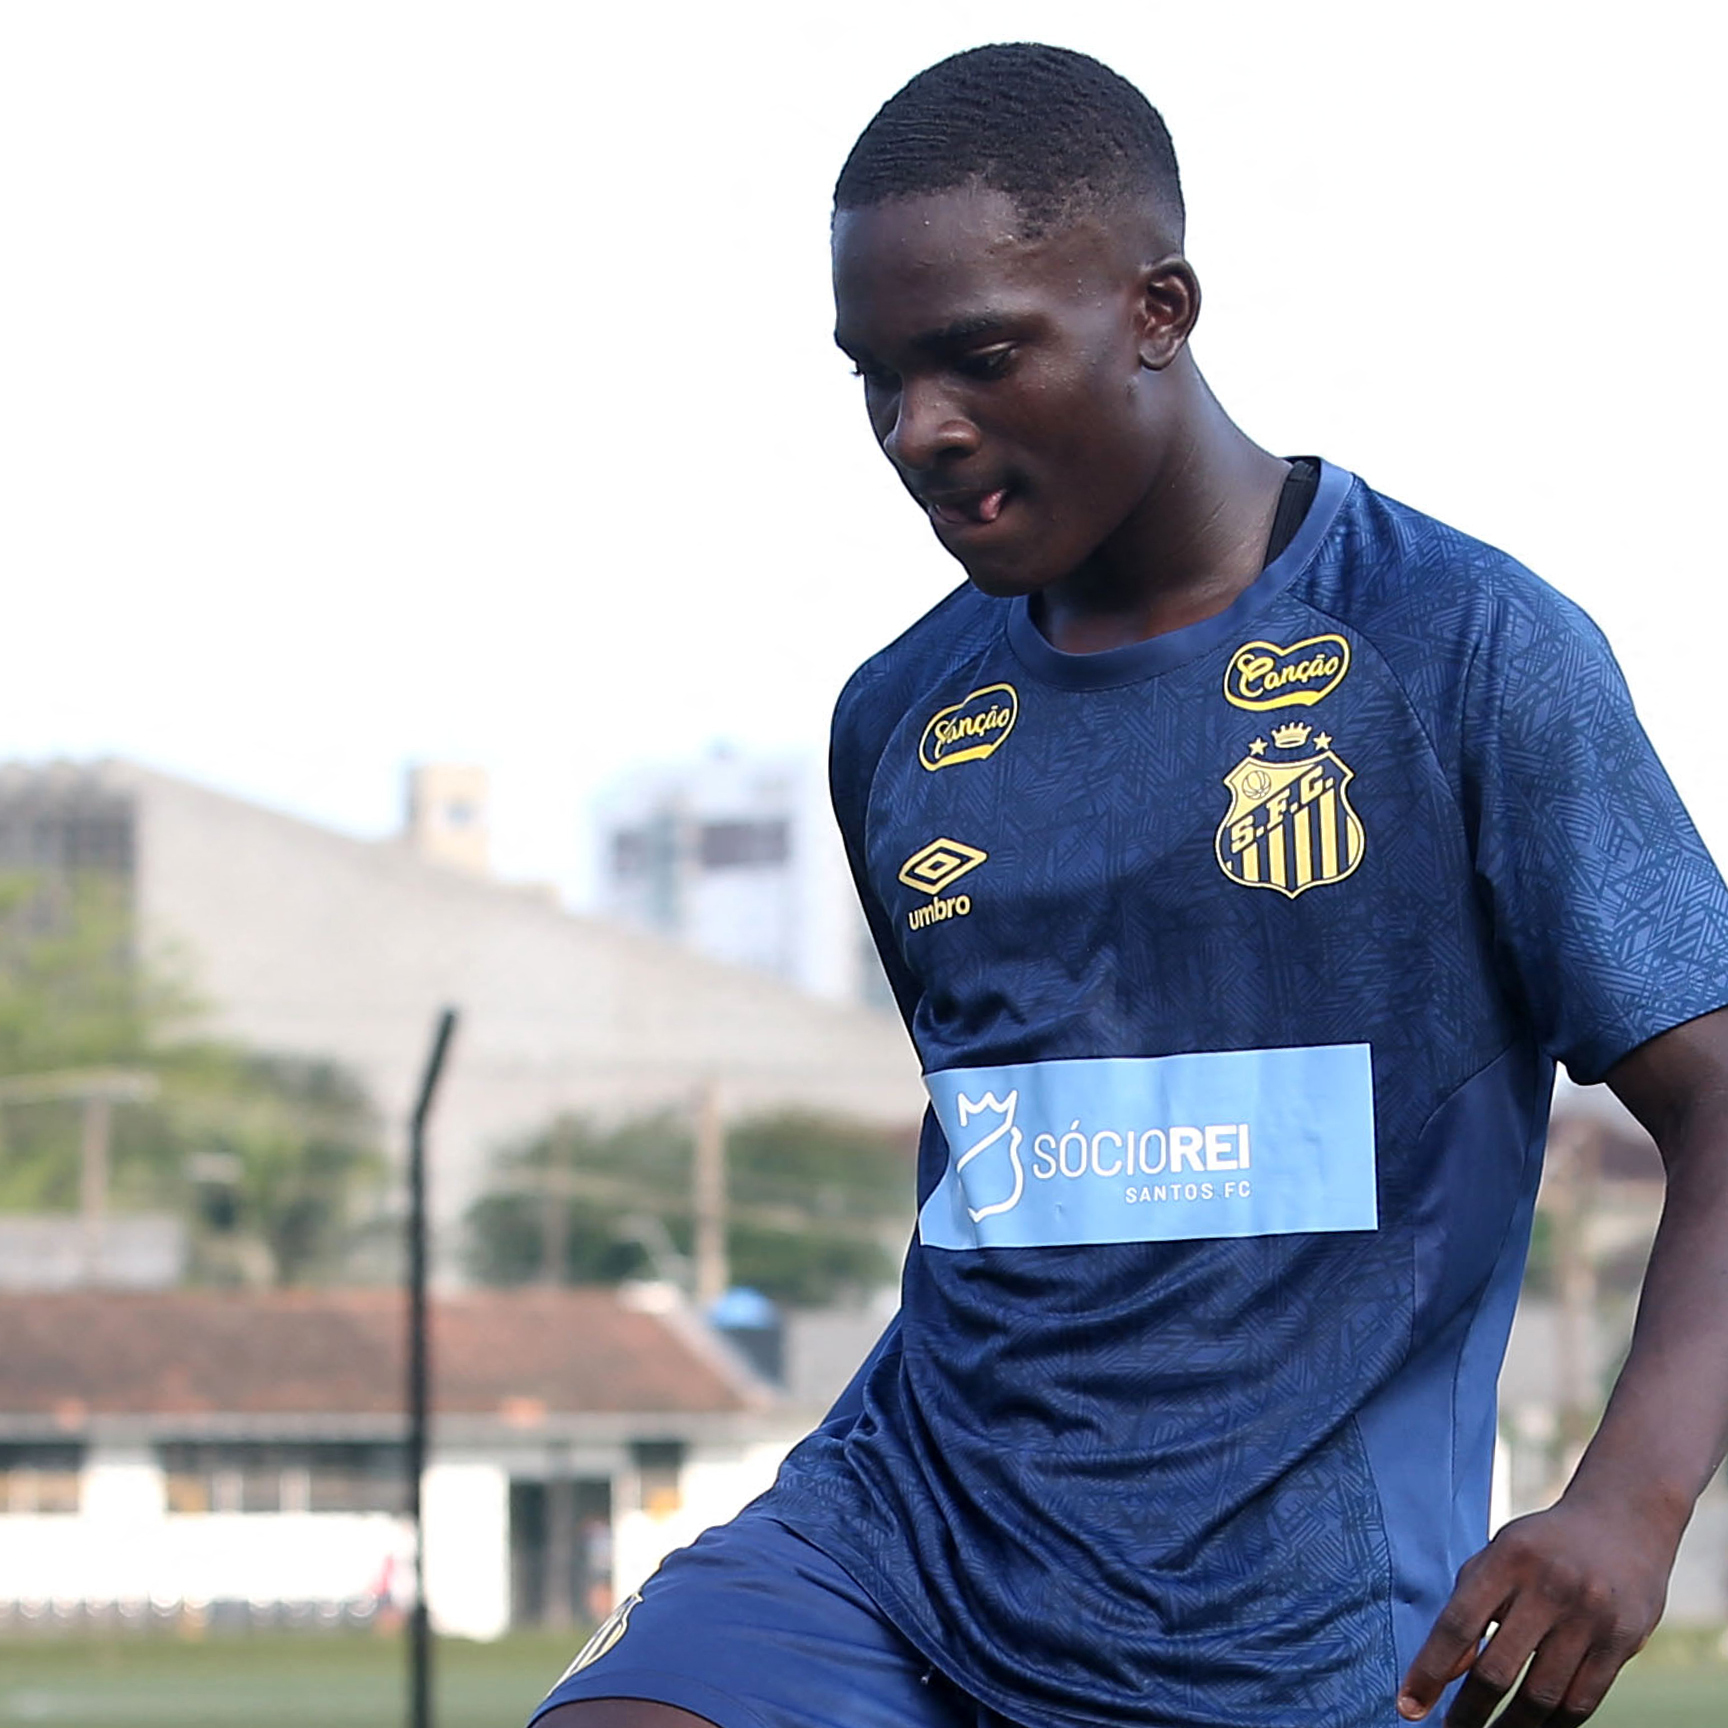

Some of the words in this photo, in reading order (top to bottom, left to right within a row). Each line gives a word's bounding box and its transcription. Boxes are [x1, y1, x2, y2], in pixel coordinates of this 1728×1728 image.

[1237, 653, 1340, 698] Canção
[907, 894, 972, 931] umbro
[1032, 1119, 1251, 1180] SÓCIOREI
[1124, 1182, 1215, 1205] SANTOS
[1223, 1179, 1252, 1199] FC
